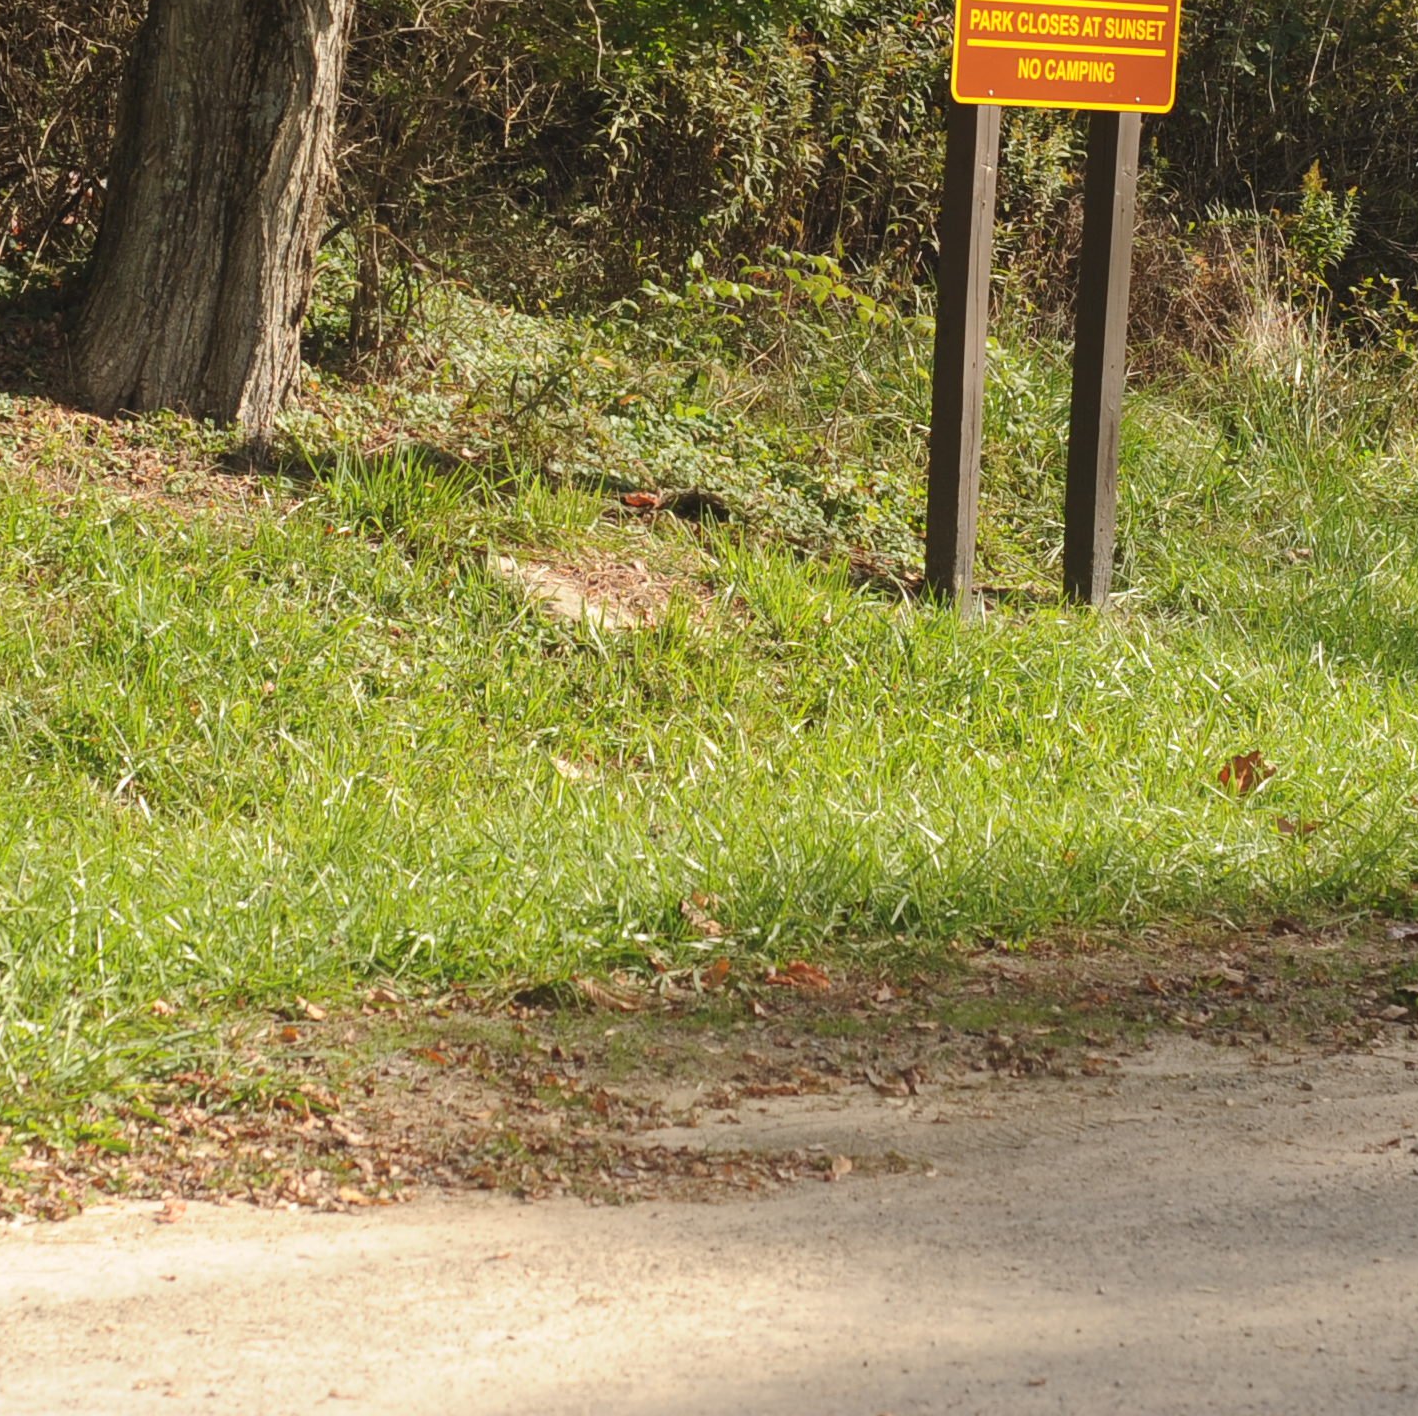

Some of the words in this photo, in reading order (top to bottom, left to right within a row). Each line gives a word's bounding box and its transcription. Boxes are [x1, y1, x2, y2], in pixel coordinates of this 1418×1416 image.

[969, 8, 1014, 33] PARK
[1017, 11, 1080, 37] CLOSES
[1081, 16, 1102, 37] AT
[1104, 17, 1166, 41] SUNSET
[1017, 57, 1042, 80] NO
[1044, 59, 1116, 83] CAMPING
